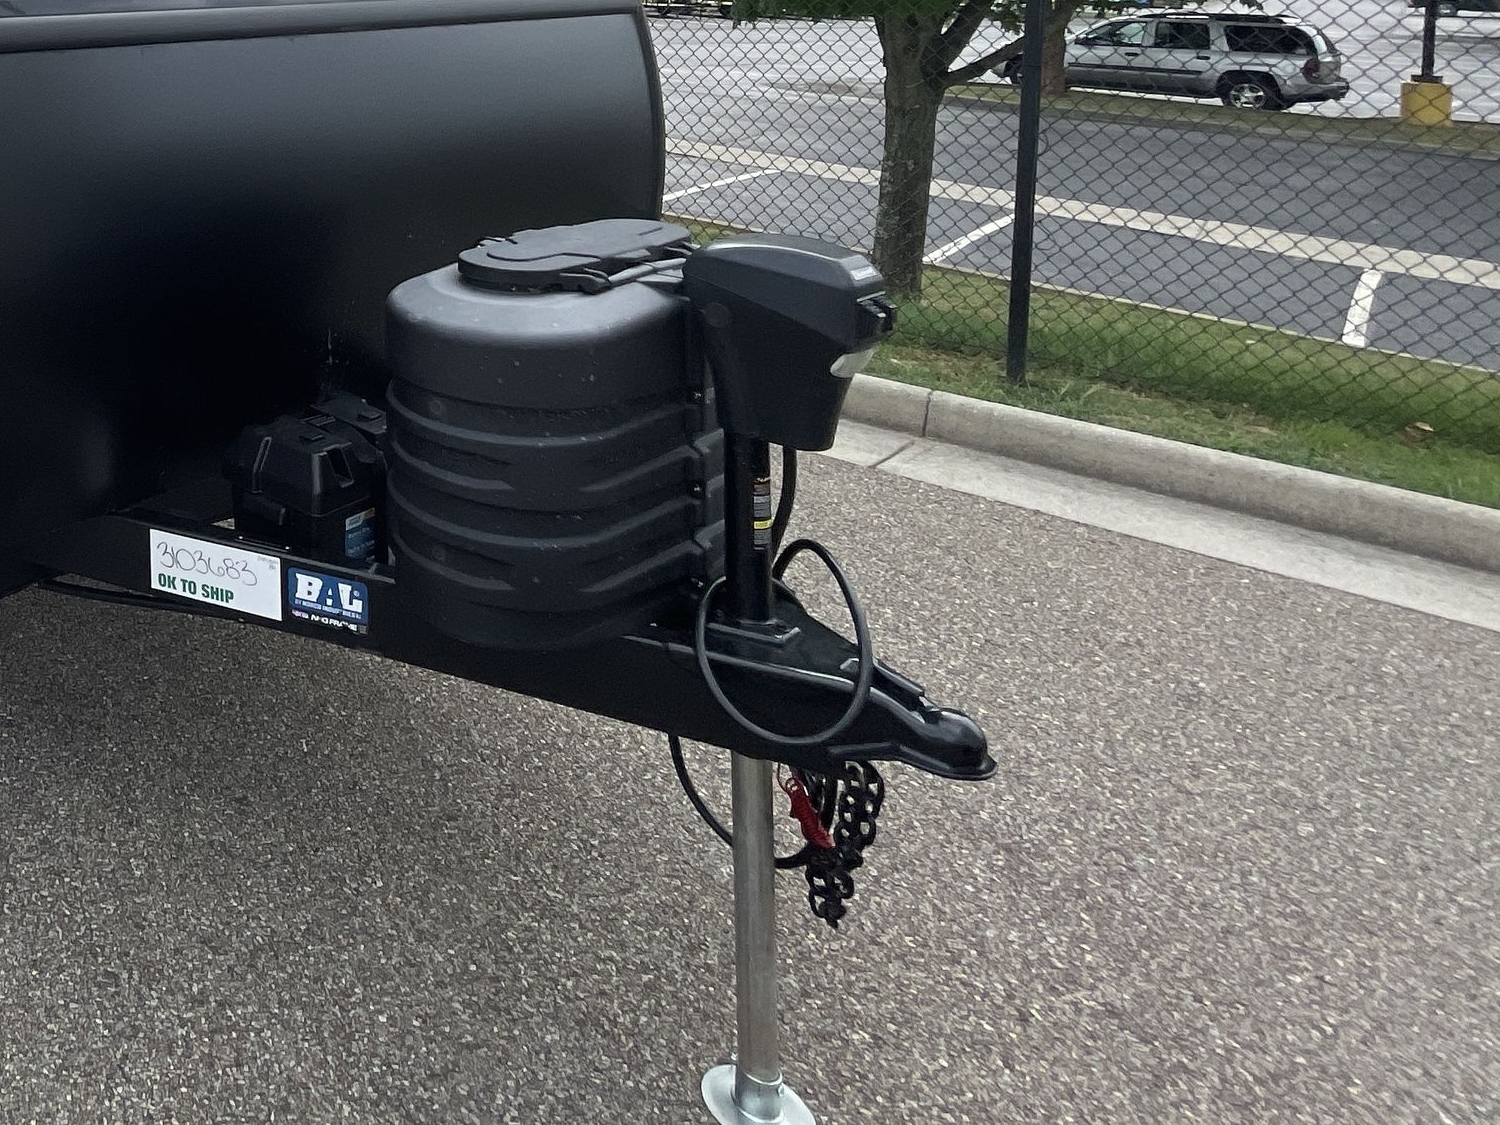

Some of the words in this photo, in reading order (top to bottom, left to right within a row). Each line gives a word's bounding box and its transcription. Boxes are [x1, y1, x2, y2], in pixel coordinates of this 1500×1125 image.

[158, 573, 177, 590] OK
[180, 578, 197, 595] TO
[201, 583, 234, 603] SHIP
[295, 572, 363, 613] BAL
